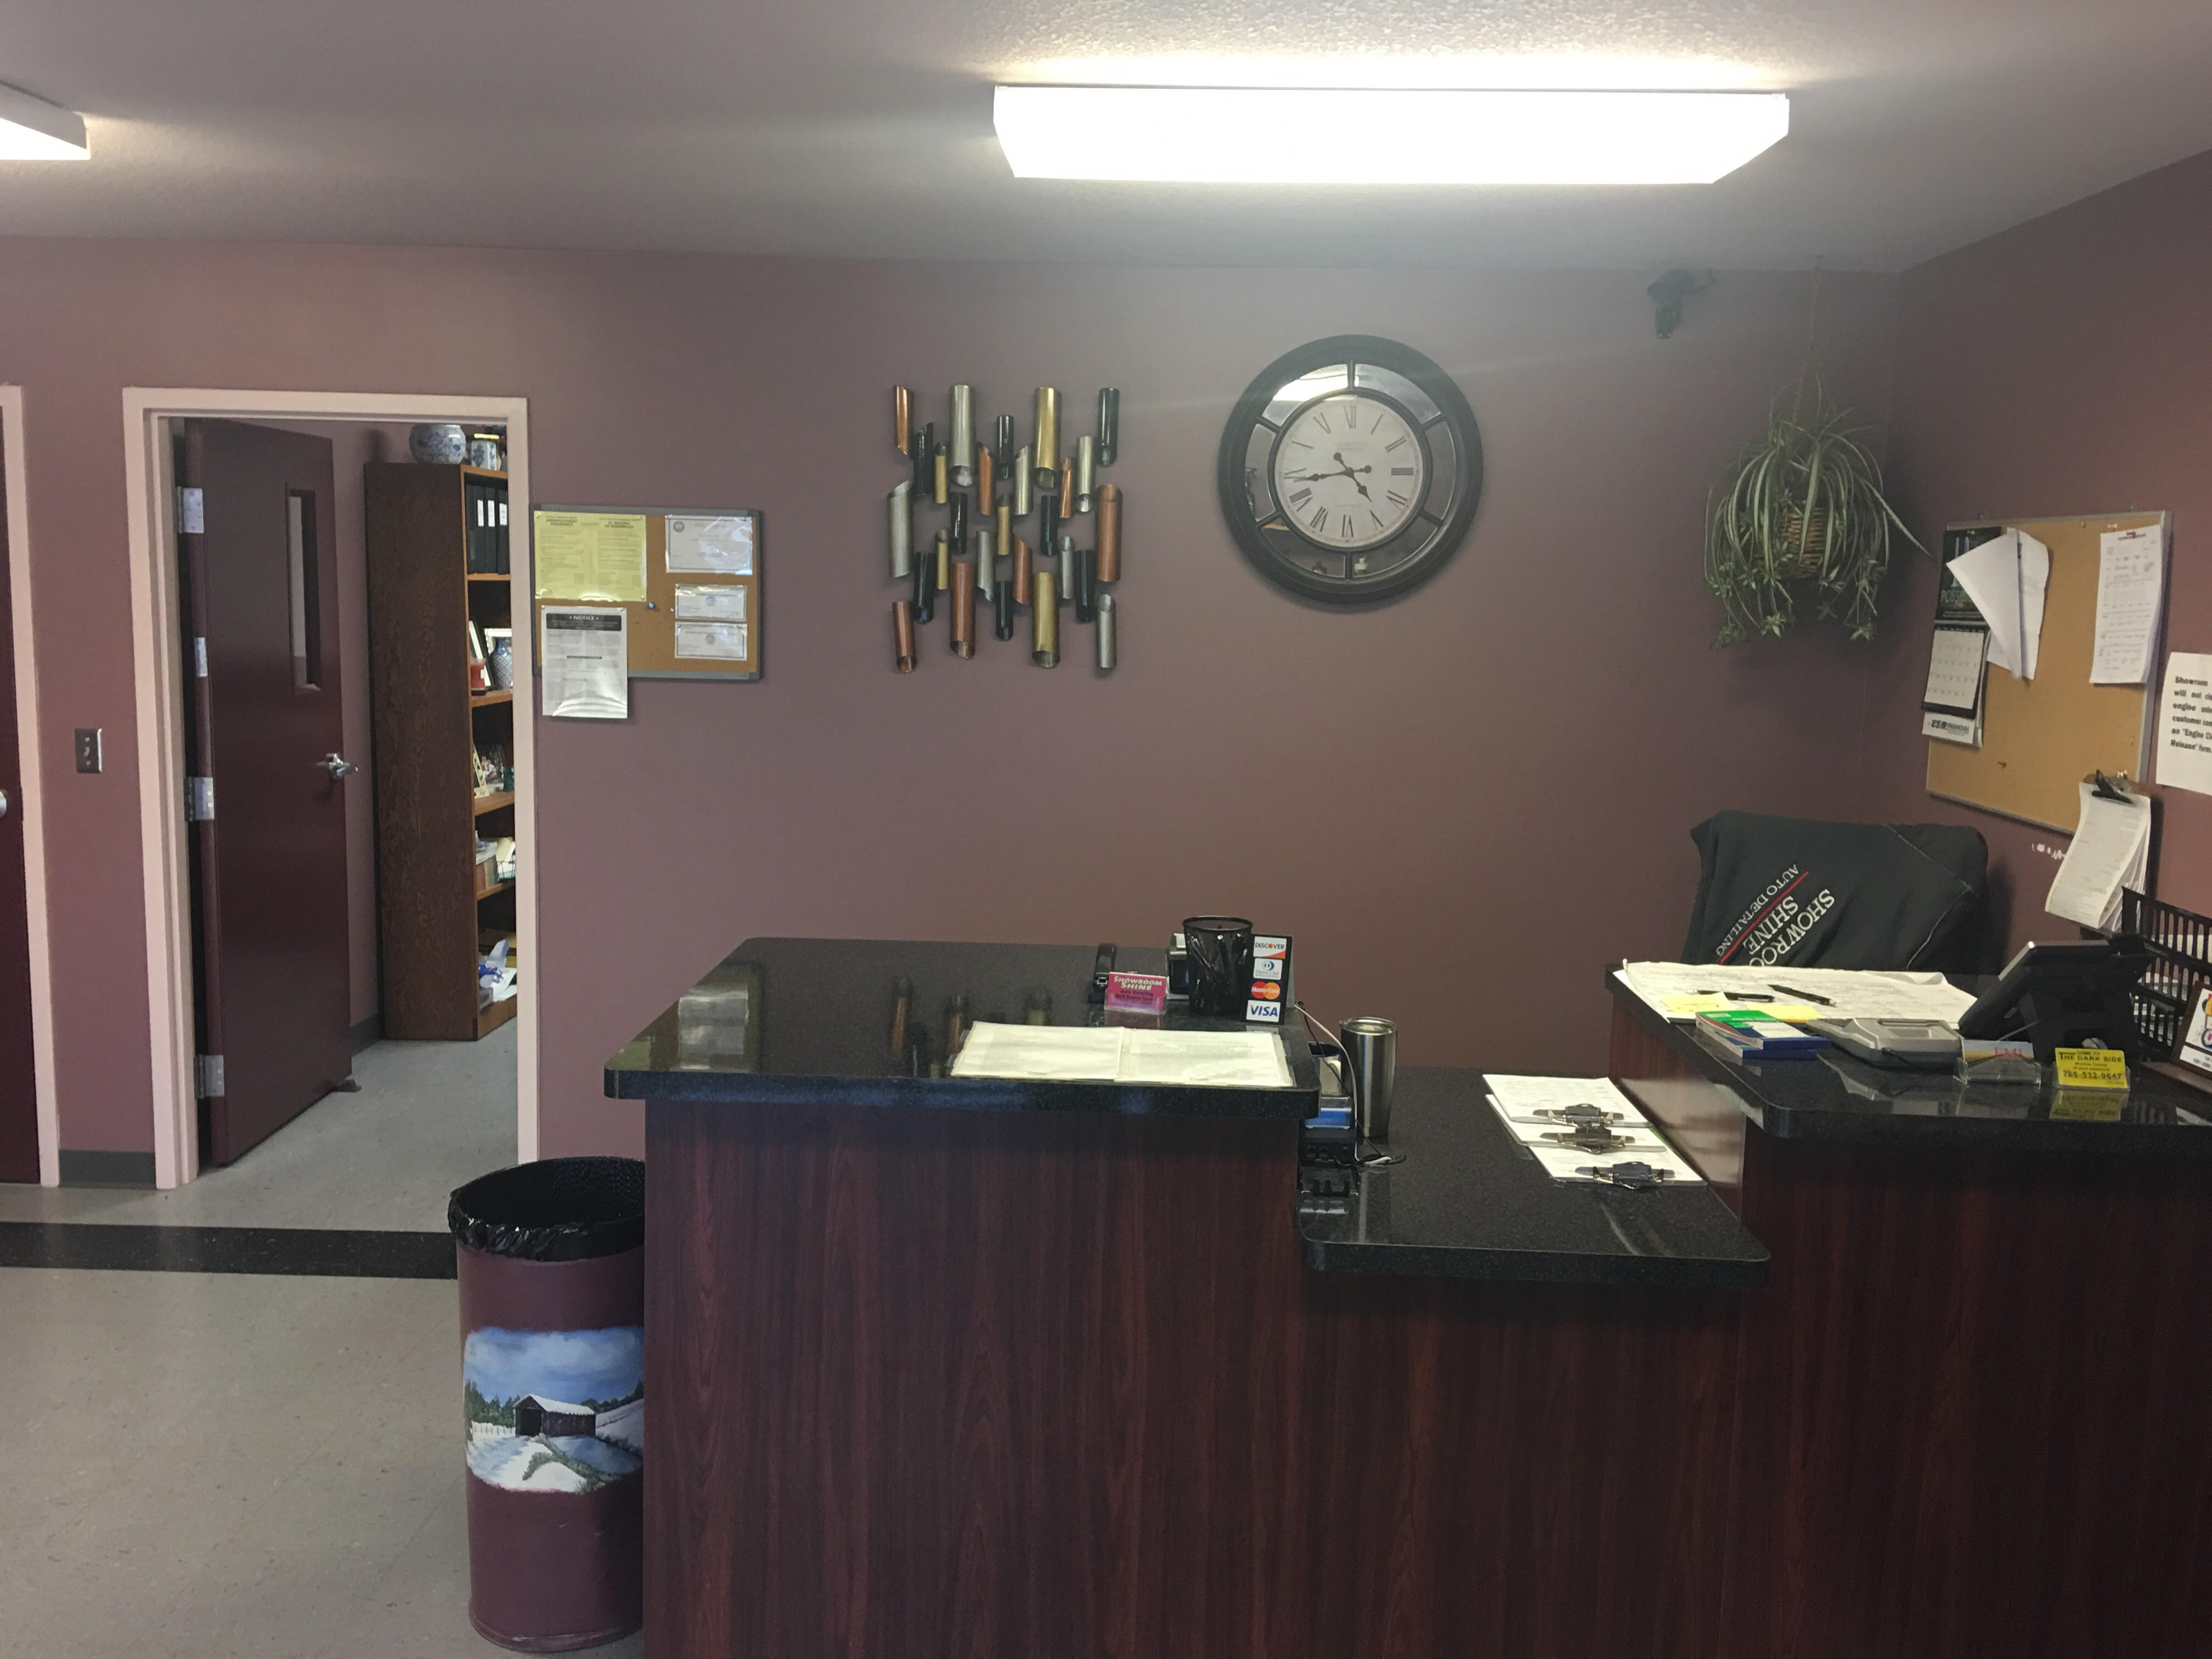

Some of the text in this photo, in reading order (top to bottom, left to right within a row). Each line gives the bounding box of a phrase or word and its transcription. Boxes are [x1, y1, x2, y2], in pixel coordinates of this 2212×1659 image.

[1385, 436, 1407, 452] II
[1391, 467, 1414, 476] III
[2175, 675, 2208, 686] Showroom
[2172, 702, 2196, 711] engine
[2172, 715, 2202, 725] customer
[1715, 864, 1800, 957] AUTO DETAILING
[1742, 895, 1799, 955] SHINE
[1114, 975, 1163, 986] SHOWROOM
[1121, 983, 1153, 991] SHINE
[1250, 1005, 1278, 1017] VISA
